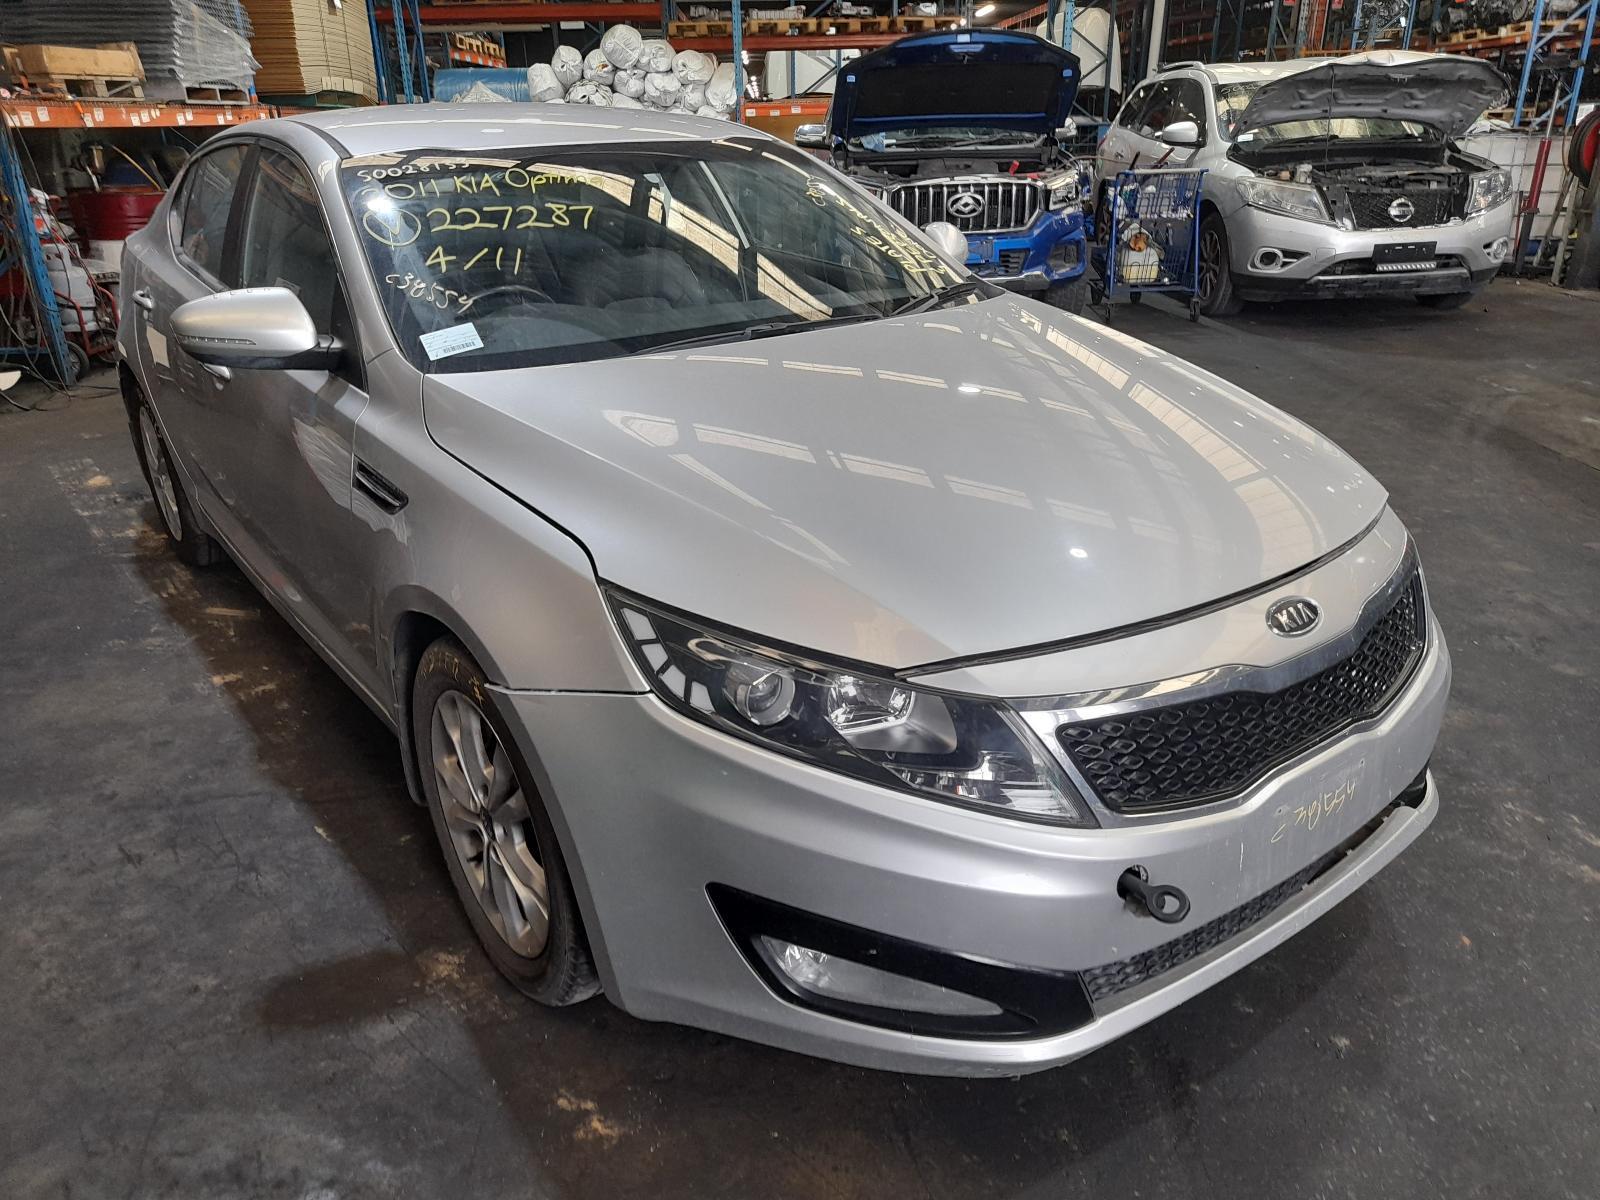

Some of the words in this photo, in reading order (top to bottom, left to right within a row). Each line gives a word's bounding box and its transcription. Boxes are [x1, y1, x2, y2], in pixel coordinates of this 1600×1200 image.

[454, 173, 501, 197] KIA
[426, 203, 594, 233] 227287
[425, 245, 522, 275] 4/11
[1274, 602, 1317, 632] KIA
